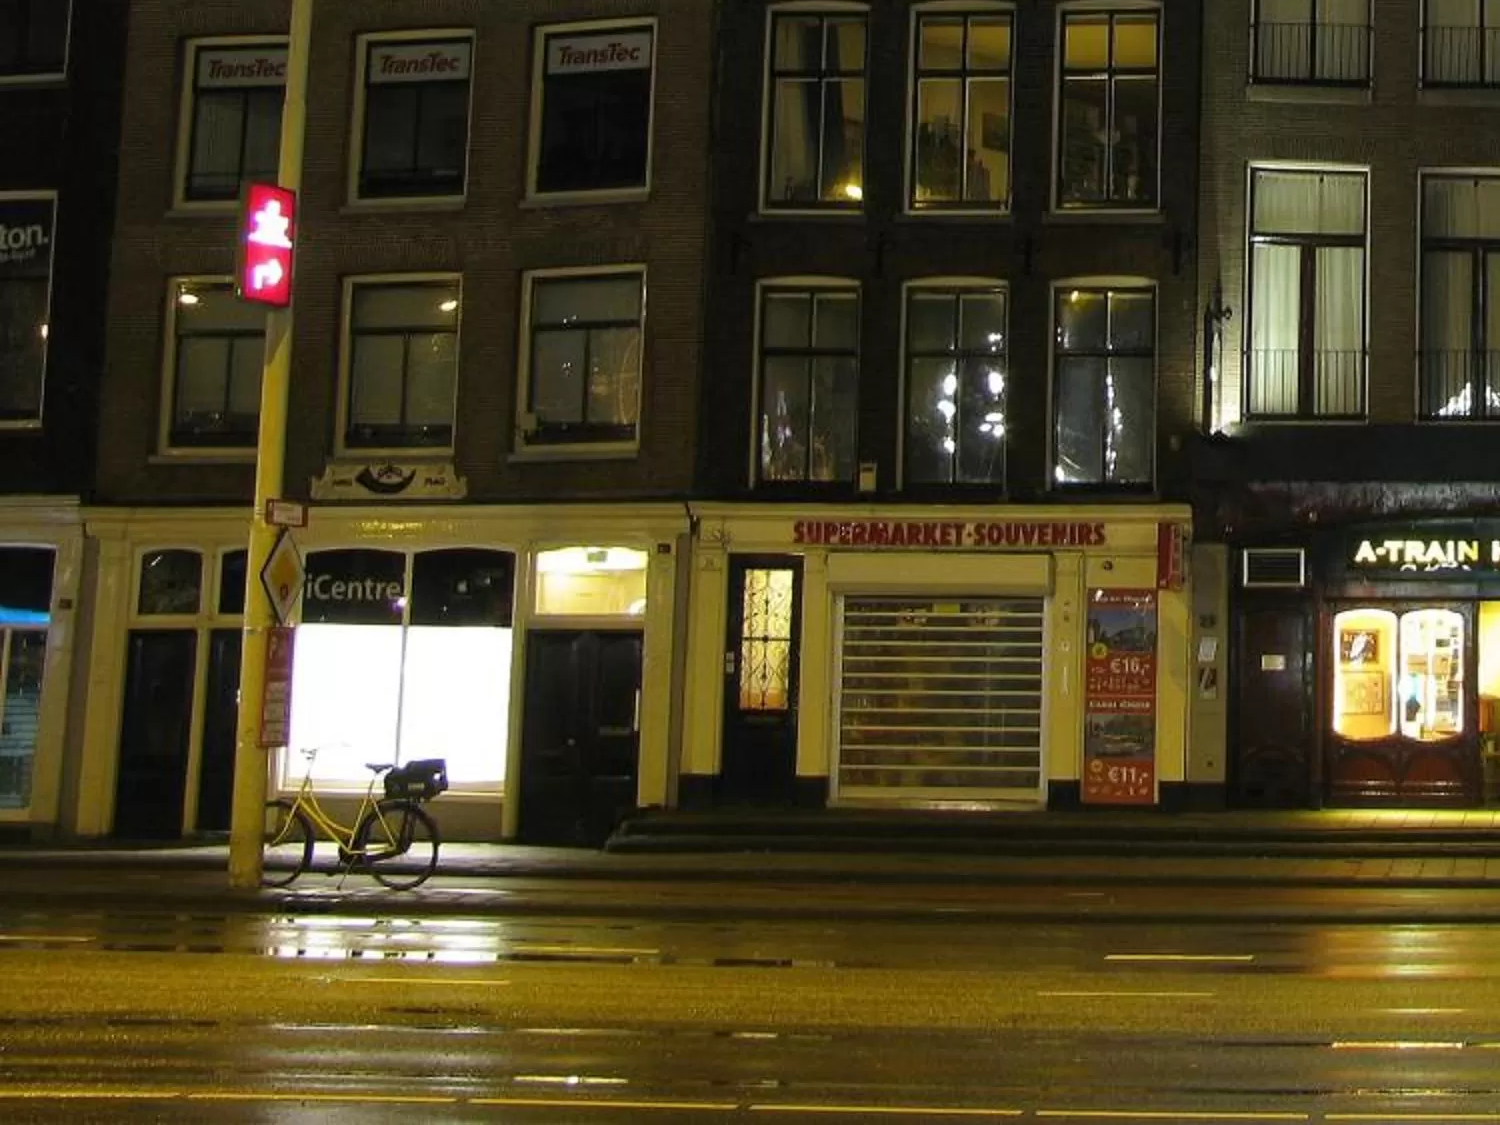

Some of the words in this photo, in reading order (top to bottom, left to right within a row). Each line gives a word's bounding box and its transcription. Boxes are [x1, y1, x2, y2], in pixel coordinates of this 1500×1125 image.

[380, 51, 461, 75] TransTec
[558, 42, 641, 66] TransTec
[305, 573, 402, 600] iCentre
